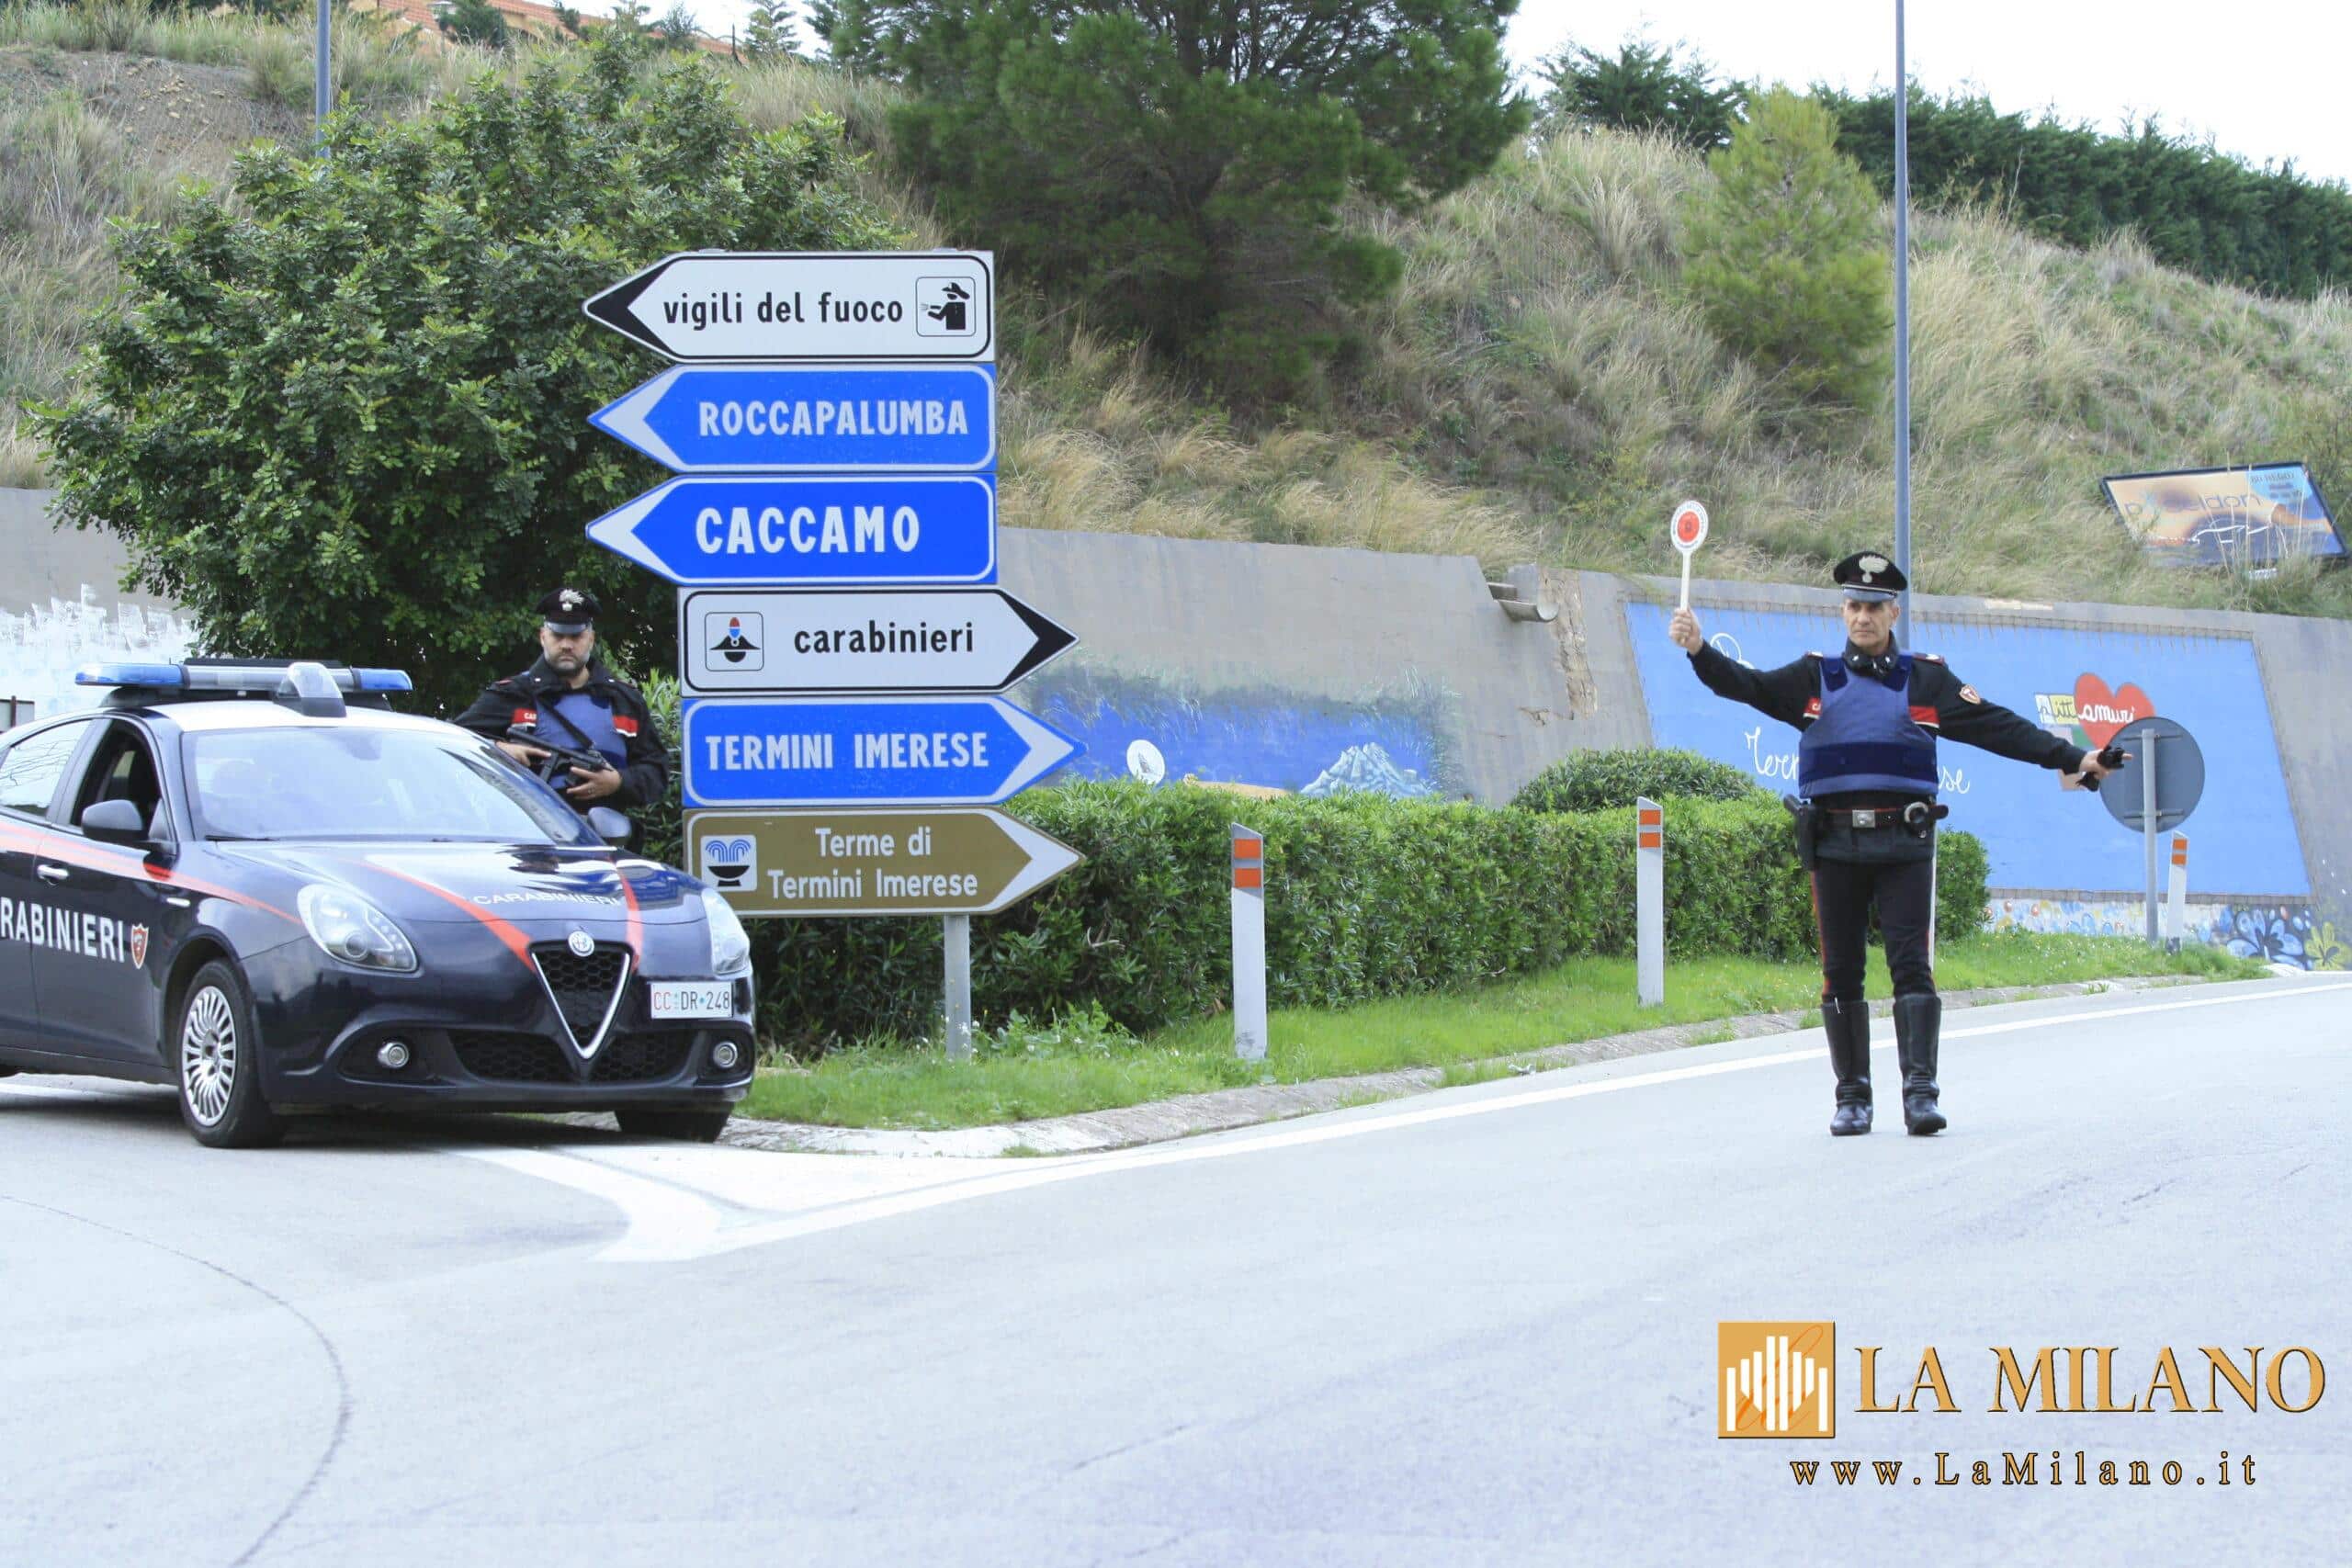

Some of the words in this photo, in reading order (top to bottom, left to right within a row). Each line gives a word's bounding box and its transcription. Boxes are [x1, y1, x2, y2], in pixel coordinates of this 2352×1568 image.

[663, 292, 742, 331] vigili
[757, 292, 805, 323] del
[819, 292, 903, 323] fuoco
[699, 400, 968, 436] ROCCAPALUMBA
[695, 506, 920, 554] CACCAMO
[794, 620, 973, 654] carabinieri
[706, 734, 833, 771] TERMINI
[854, 732, 989, 769] IMERESE
[814, 827, 895, 857] Terme
[908, 826, 932, 856] di
[472, 892, 622, 906] CARABINIERI
[767, 869, 862, 899] Termini
[876, 868, 978, 897] Imerese
[706, 991, 730, 1011] 248
